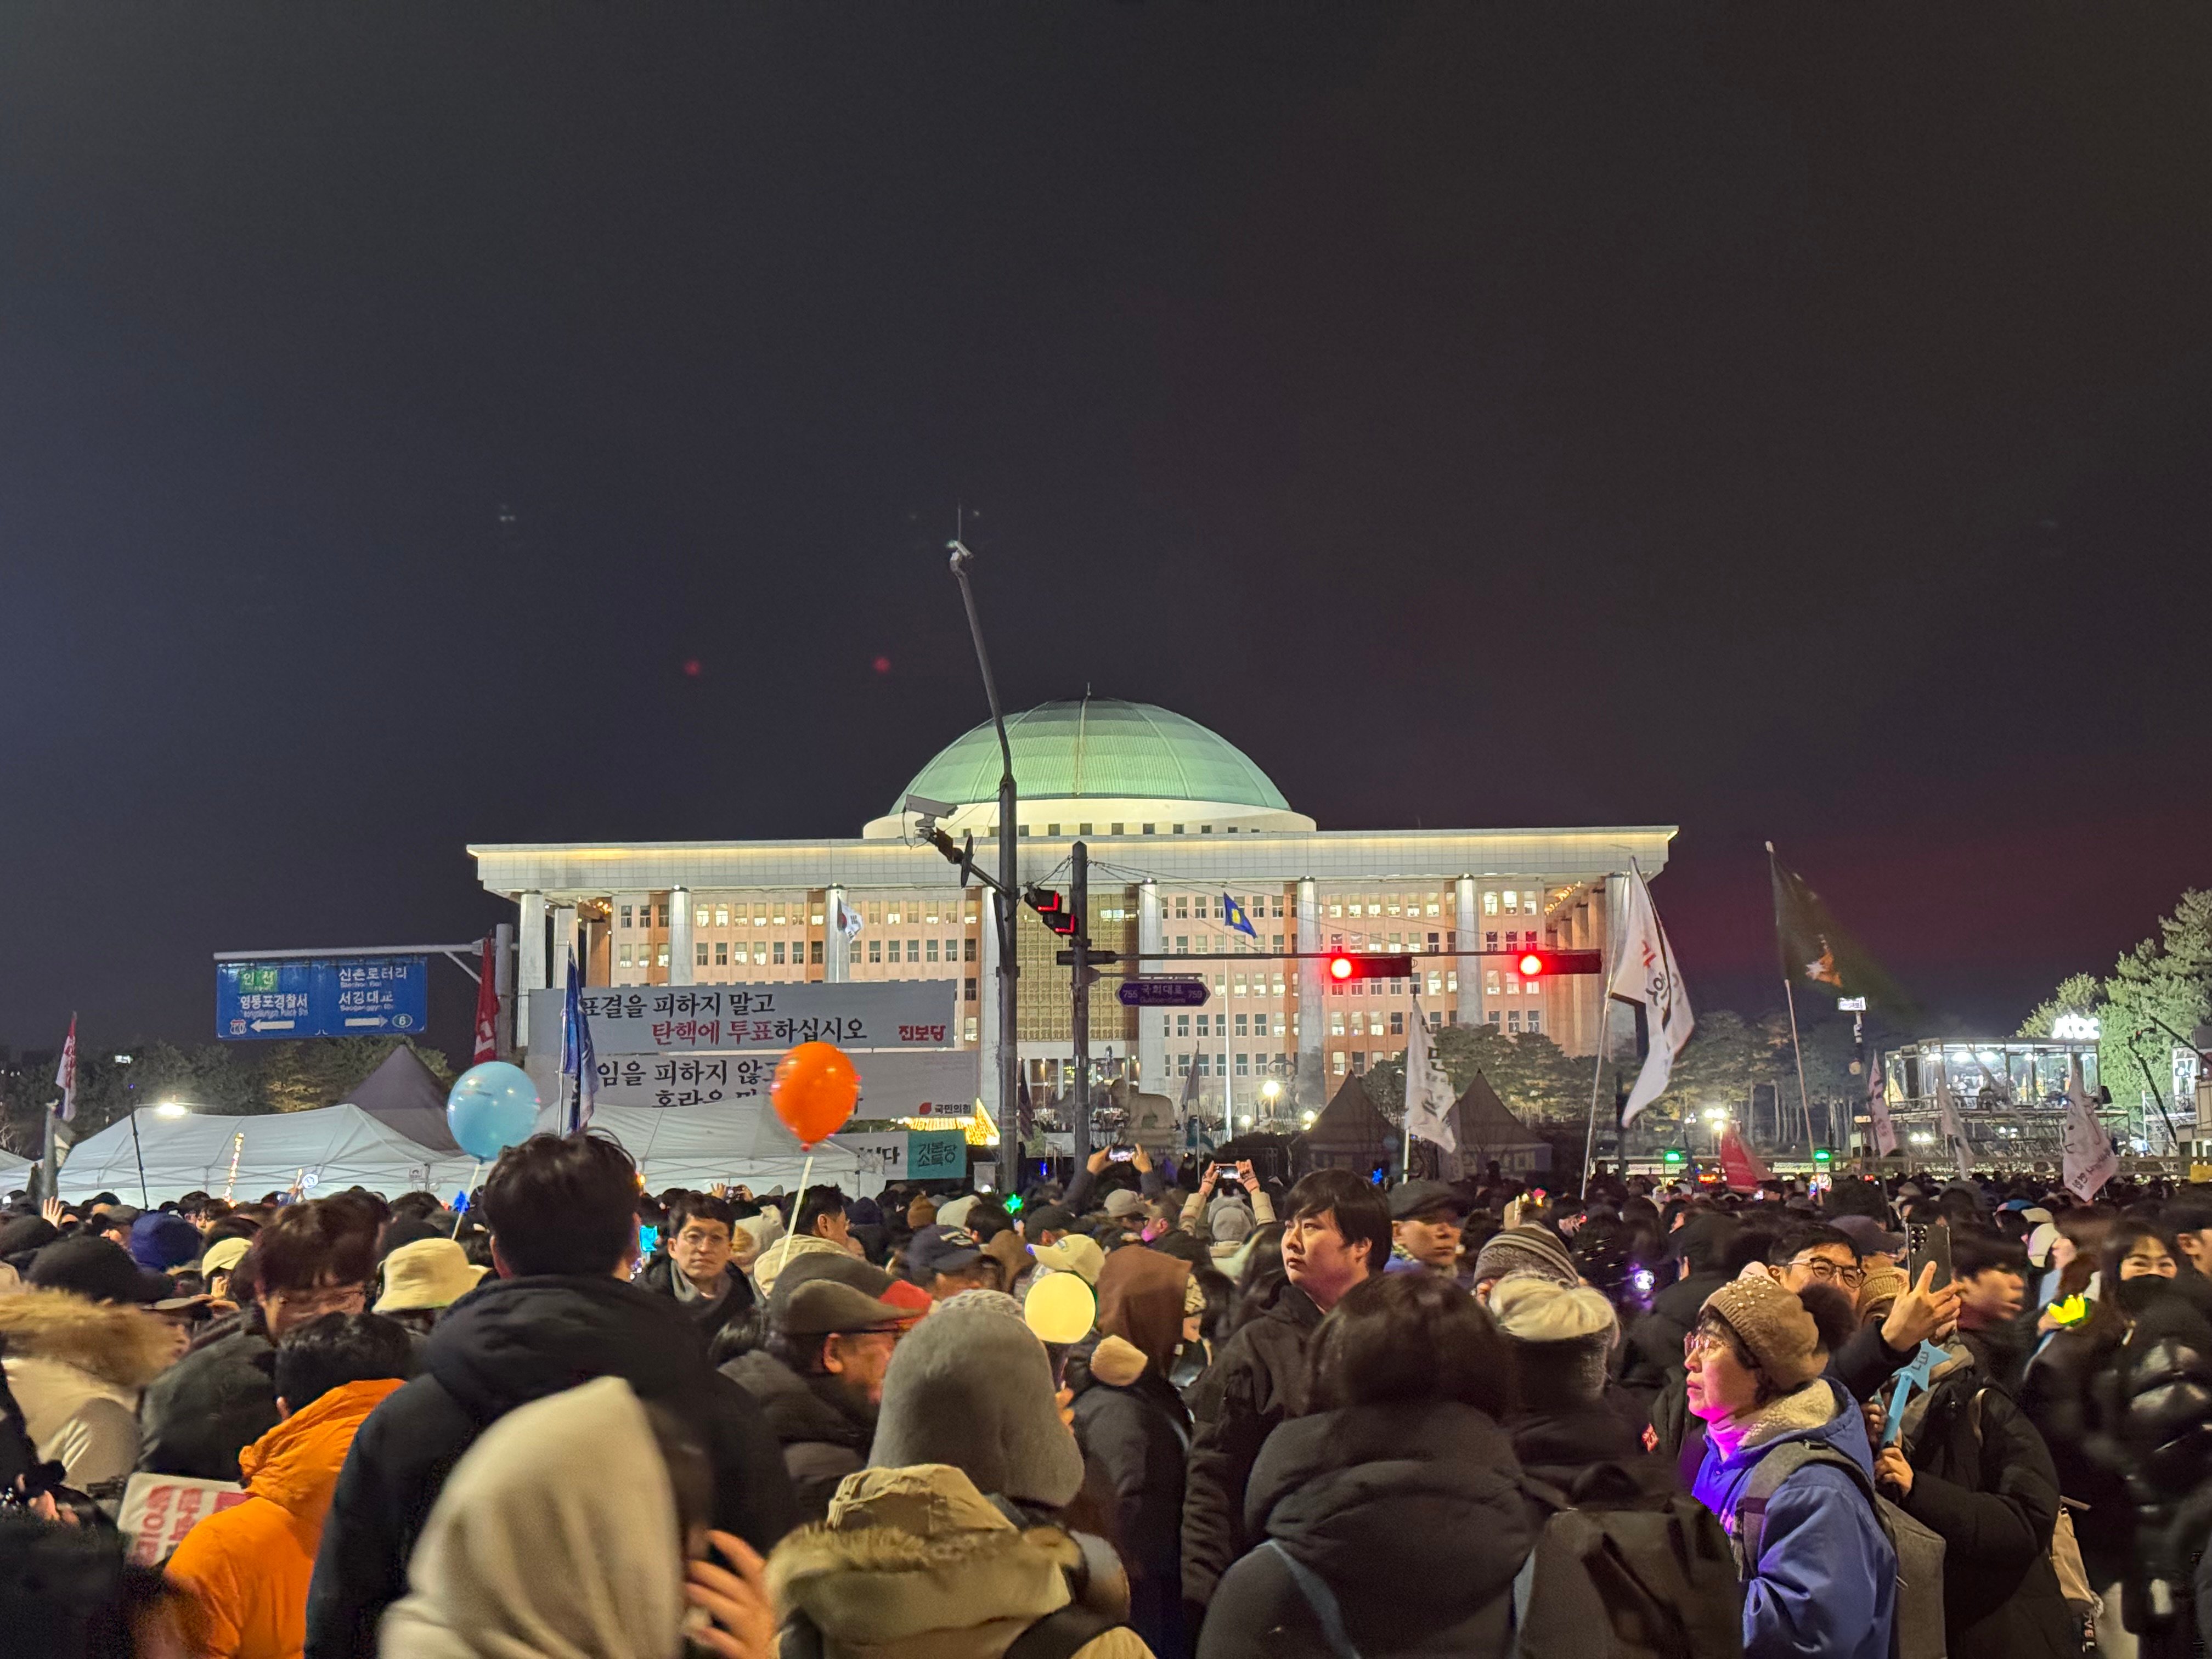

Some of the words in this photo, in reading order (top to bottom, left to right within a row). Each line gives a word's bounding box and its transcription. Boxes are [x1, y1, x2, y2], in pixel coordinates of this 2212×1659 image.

[338, 966, 407, 981] 신촌로터리
[1142, 984, 1183, 995] 국회대로
[653, 992, 721, 1018] 피하지
[729, 991, 776, 1015] 말고
[398, 1015, 407, 1026] 6
[652, 1019, 720, 1046] 탄핵에
[727, 1017, 868, 1043] 투표하십시오
[898, 1024, 946, 1042] 진보당
[597, 1060, 647, 1087] 임을
[654, 1059, 727, 1086] 피하지
[934, 1103, 971, 1114] 국민의힘
